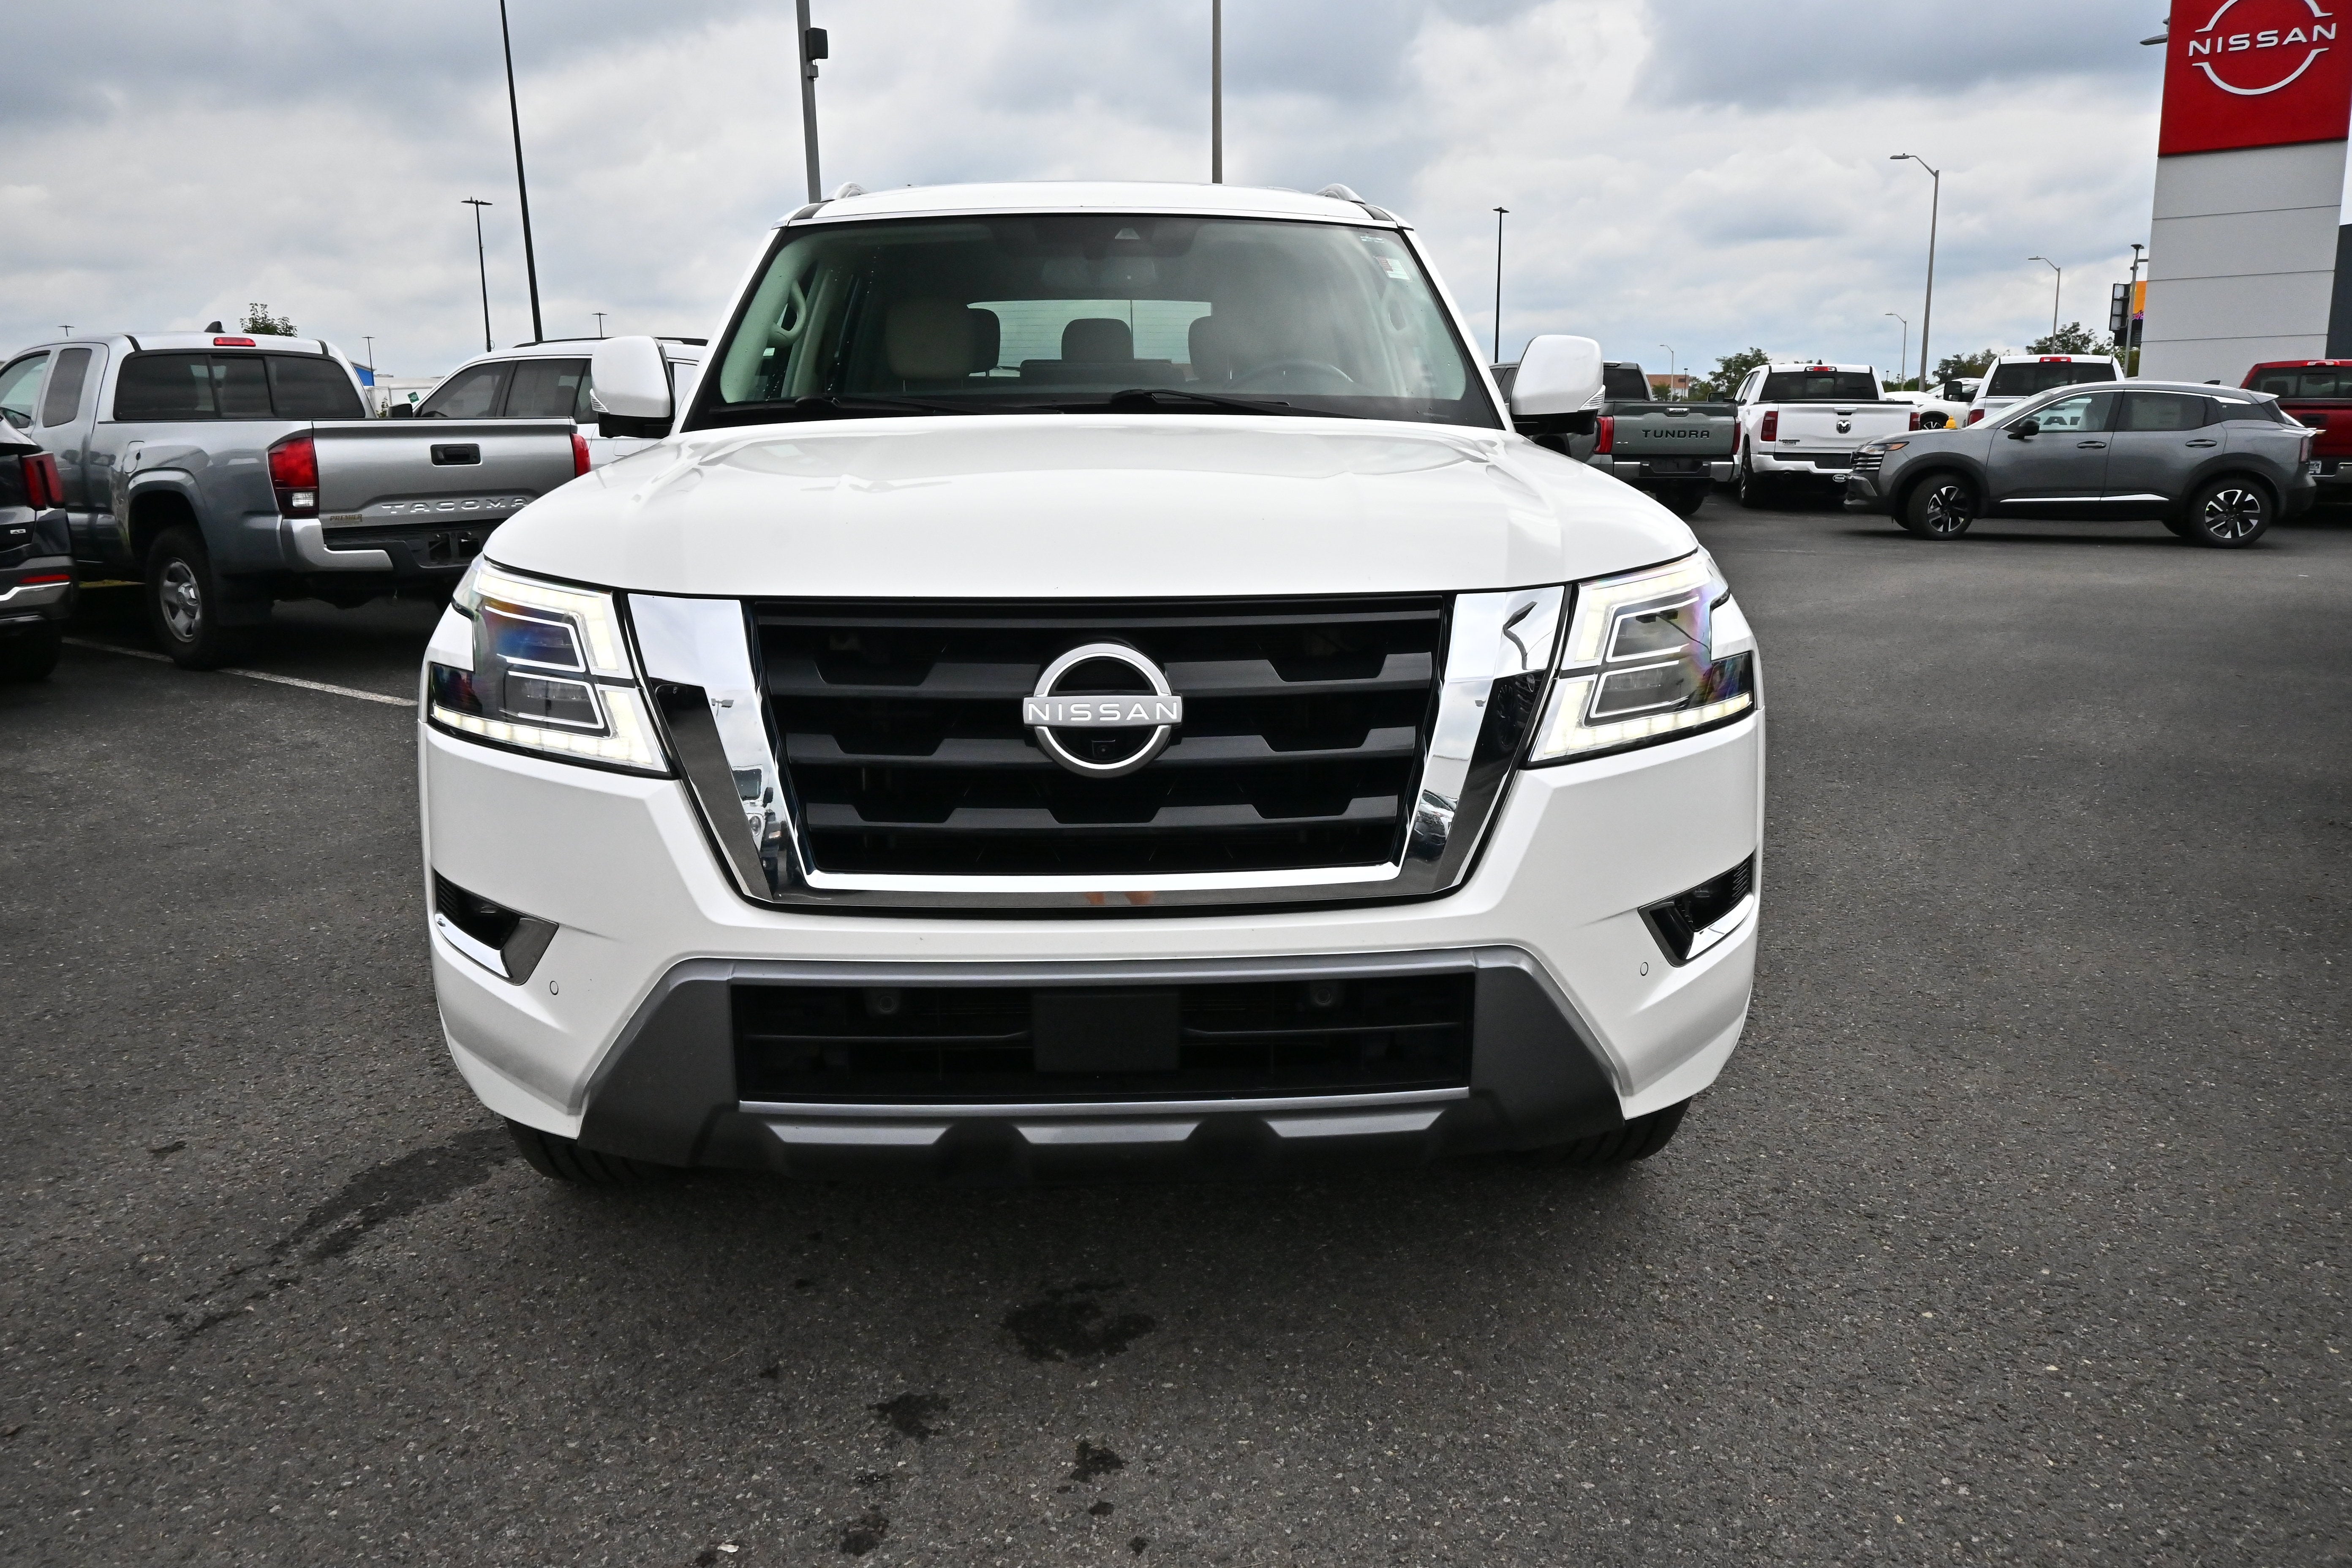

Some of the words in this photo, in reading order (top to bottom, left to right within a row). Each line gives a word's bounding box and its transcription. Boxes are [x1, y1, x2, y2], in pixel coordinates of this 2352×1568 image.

[2188, 23, 2336, 57] NISSAN
[1642, 429, 1710, 438] TUNDRA
[381, 497, 528, 514] TACOMA
[1028, 702, 1177, 721] NISSAN
